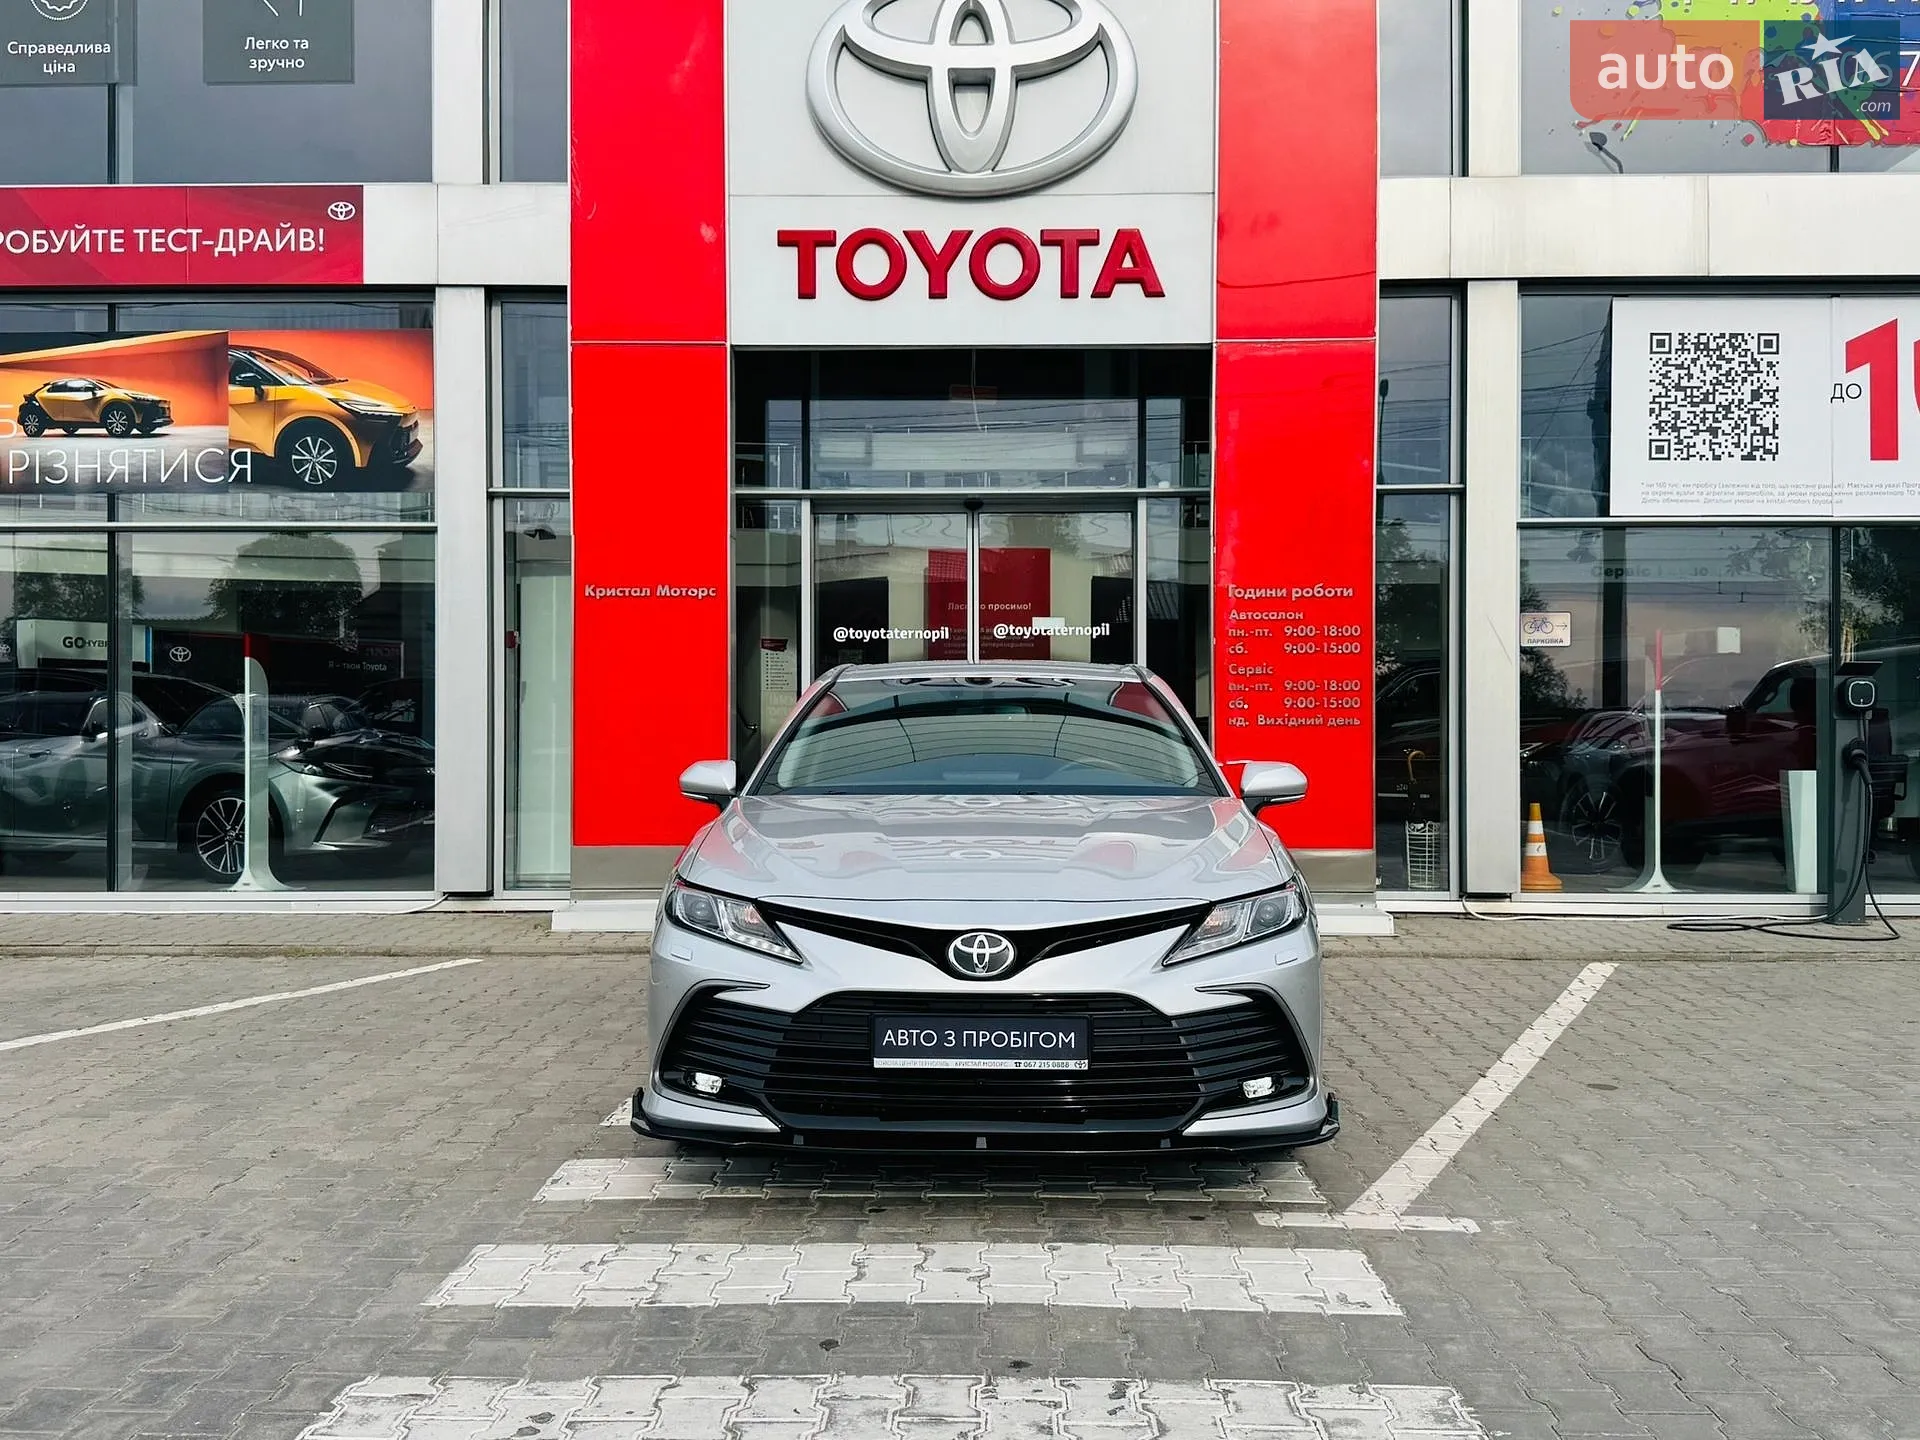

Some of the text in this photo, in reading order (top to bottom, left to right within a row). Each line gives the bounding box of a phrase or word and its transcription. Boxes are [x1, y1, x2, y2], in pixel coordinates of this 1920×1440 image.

[7, 41, 111, 57] Справедлива
[244, 36, 309, 50] Легко та
[43, 59, 76, 75] ціна
[248, 58, 305, 72] зручно
[133, 222, 325, 258] ТЕСТ-ДРАЙВ!
[777, 227, 1166, 301] TOYOTA
[1844, 317, 1920, 462] 1
[8, 448, 253, 485] РІЗНЯТИСЯ
[584, 584, 717, 599] Кристал Моторс
[1228, 583, 1354, 600] Години роботи
[988, 603, 1032, 611] просимо!
[1229, 609, 1304, 620] Автосалон
[833, 627, 950, 642] @toyotaternopil
[993, 623, 1110, 639] @toyotaternopil
[1228, 642, 1248, 654] сб.
[1228, 663, 1275, 677] Сервіс
[1228, 697, 1249, 709] сб.
[1228, 713, 1361, 727] нд. Вихідний день
[882, 1029, 1076, 1049] АВТО З ПРОБІГОМ
[1038, 1061, 1051, 1069] 215
